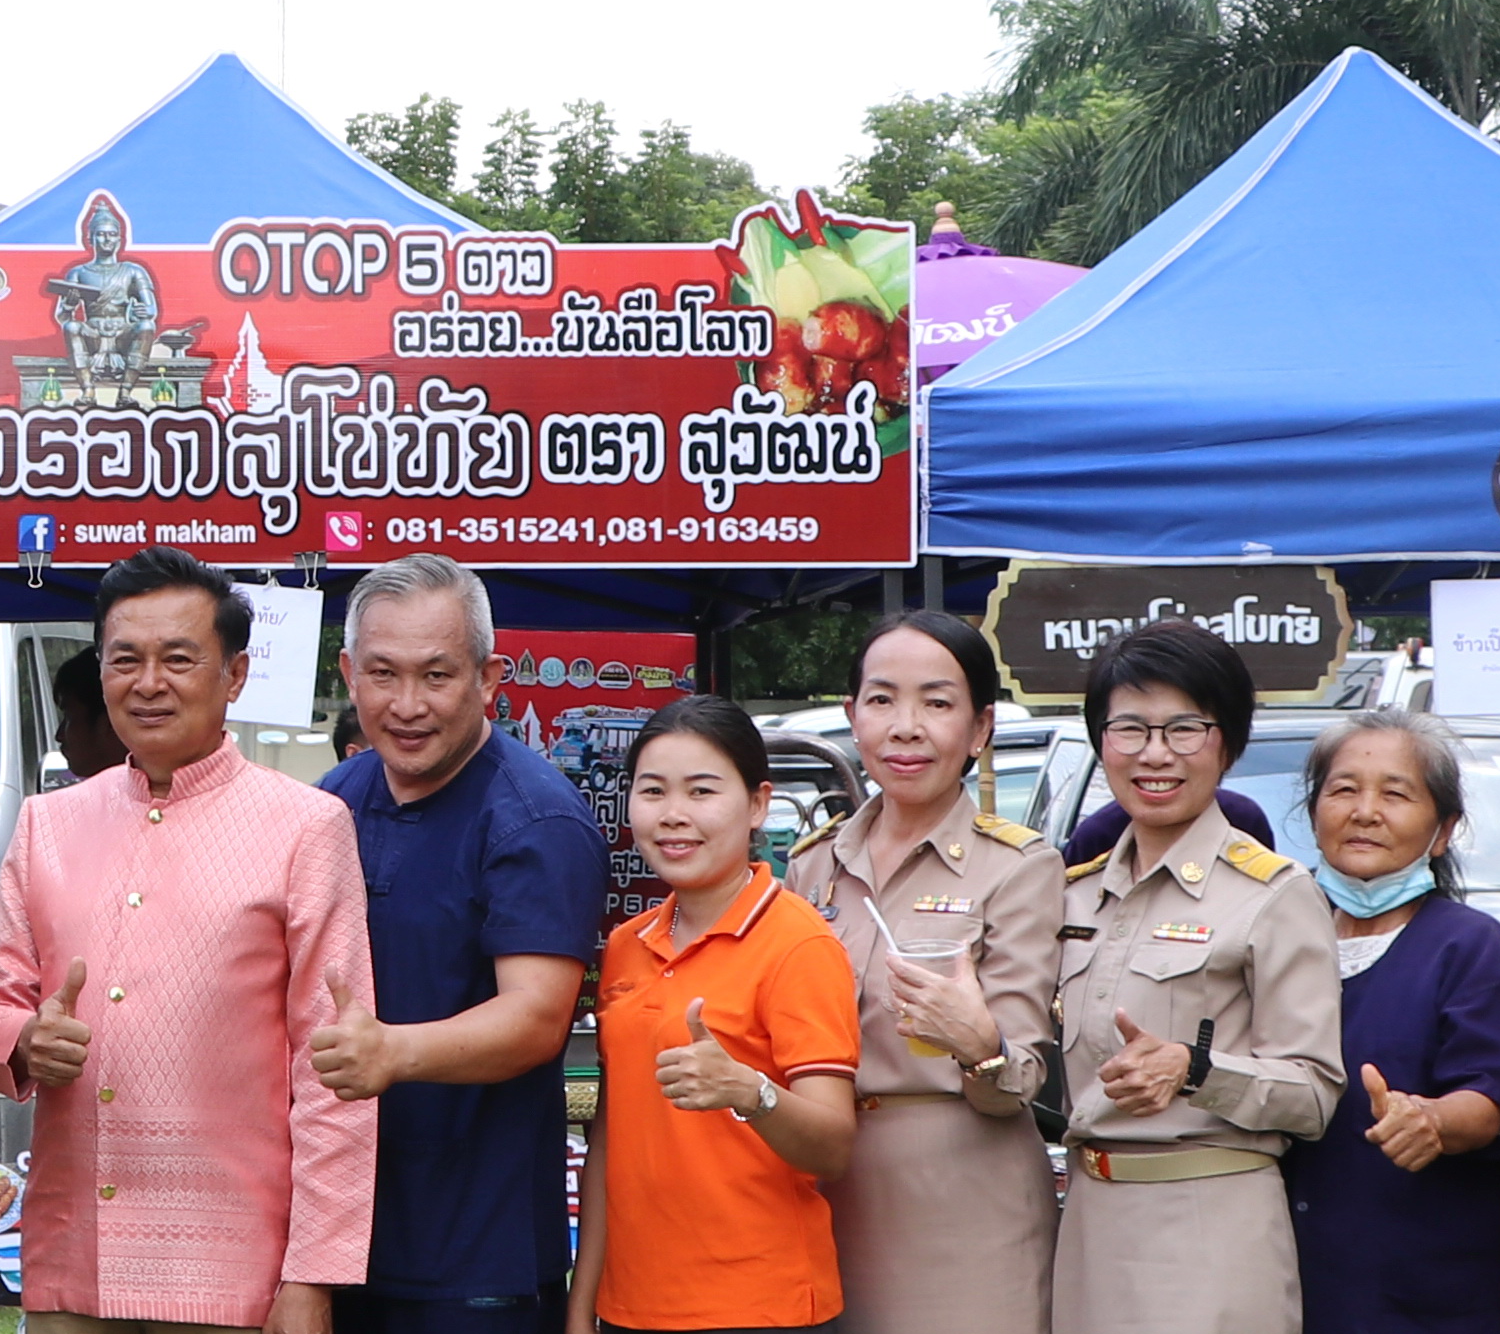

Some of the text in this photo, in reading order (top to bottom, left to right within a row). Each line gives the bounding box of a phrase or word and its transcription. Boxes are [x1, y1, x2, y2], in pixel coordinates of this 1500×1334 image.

[220, 232, 555, 296] OTOP 5 ดาว
[540, 414, 665, 484] ตรา
[680, 380, 881, 513] สุวัฒน์
[74, 520, 257, 544] suwat makham
